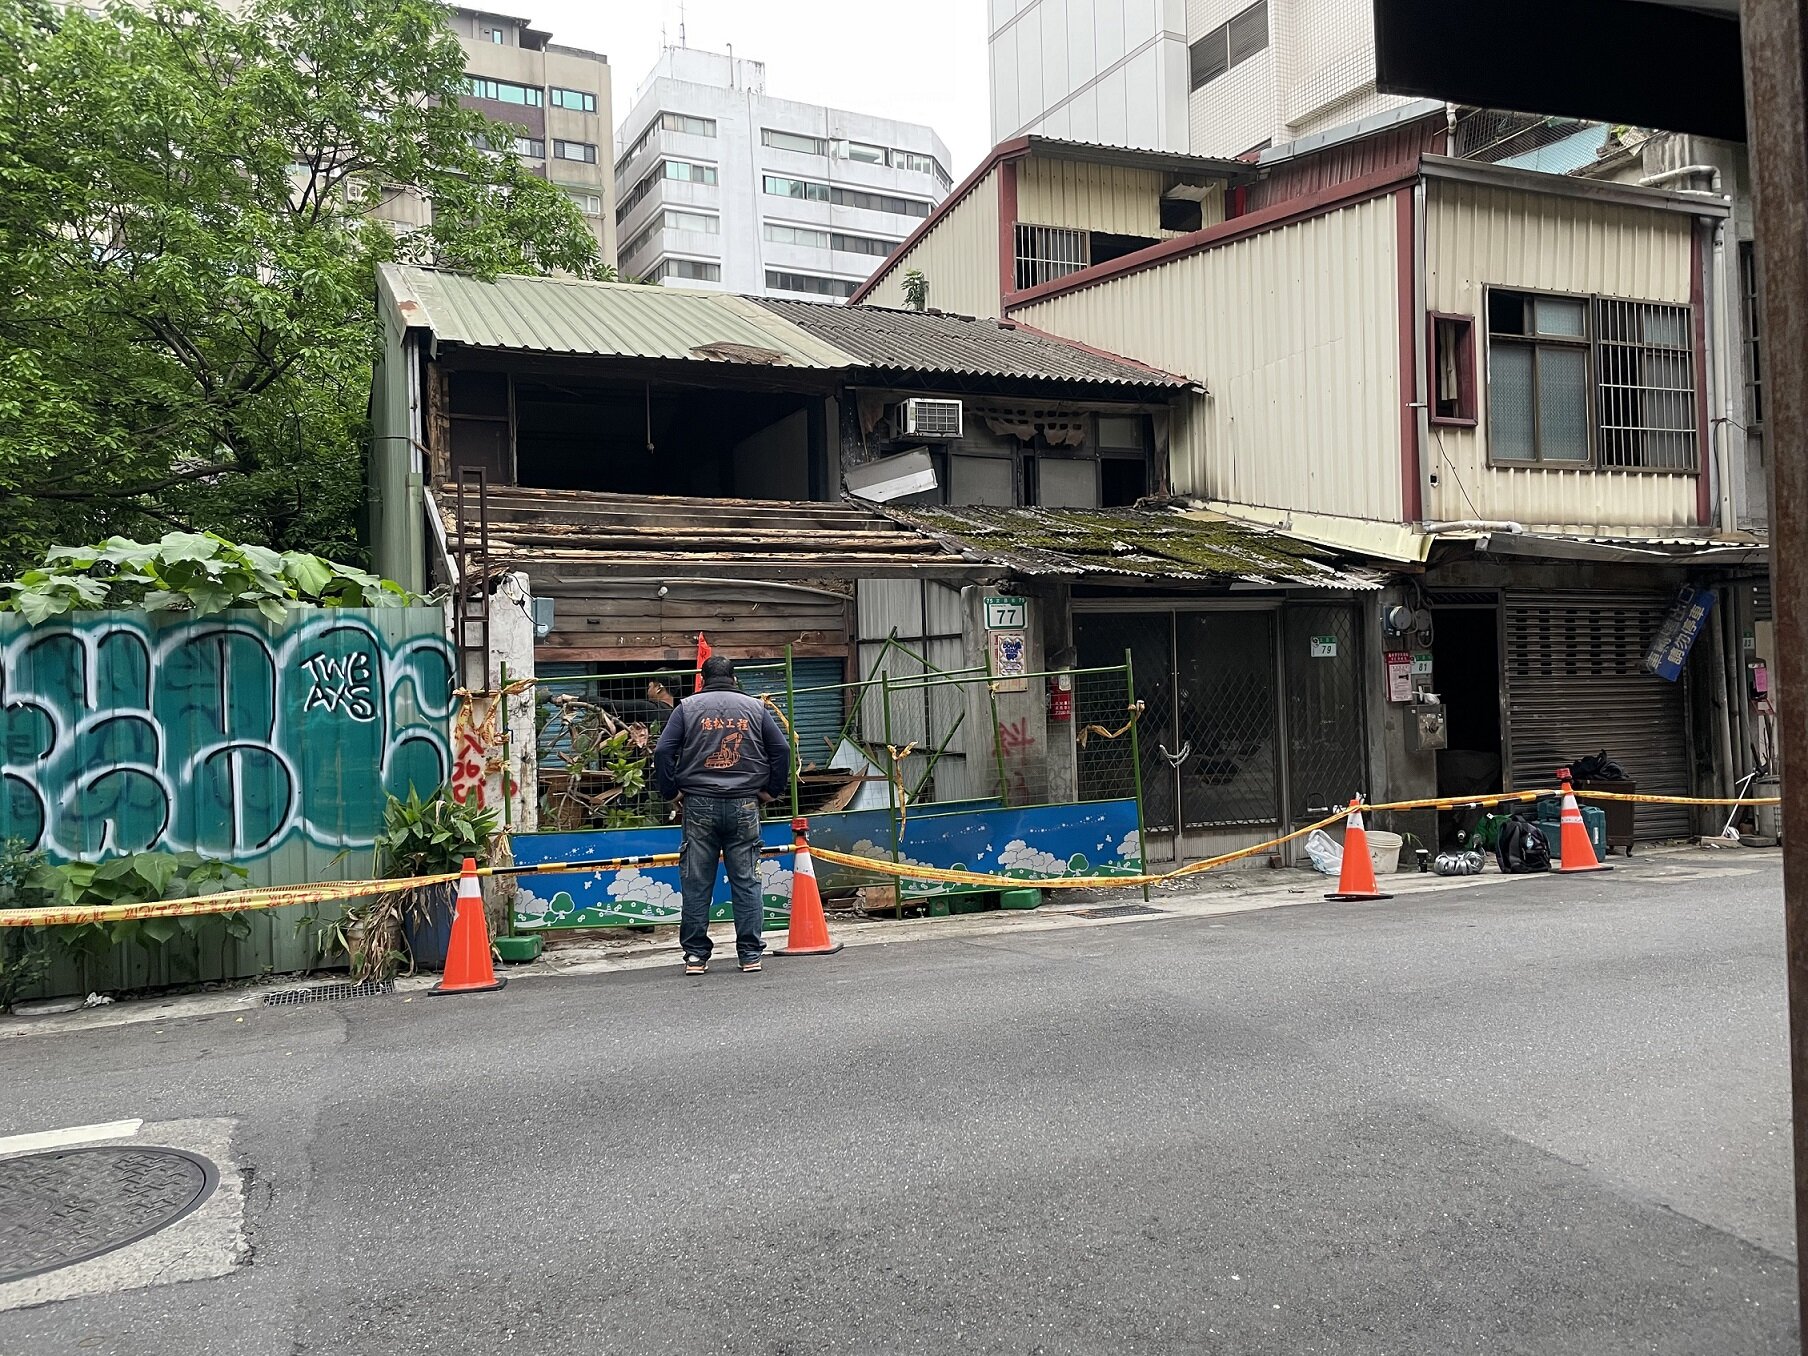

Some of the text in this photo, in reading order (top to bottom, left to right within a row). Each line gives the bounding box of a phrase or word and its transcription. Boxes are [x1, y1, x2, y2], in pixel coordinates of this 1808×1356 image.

[996, 609, 1017, 625] 77
[1667, 604, 1705, 665] 請勿停車
[1321, 645, 1332, 654] 79
[1418, 662, 1428, 672] 81
[302, 684, 376, 722] AXS
